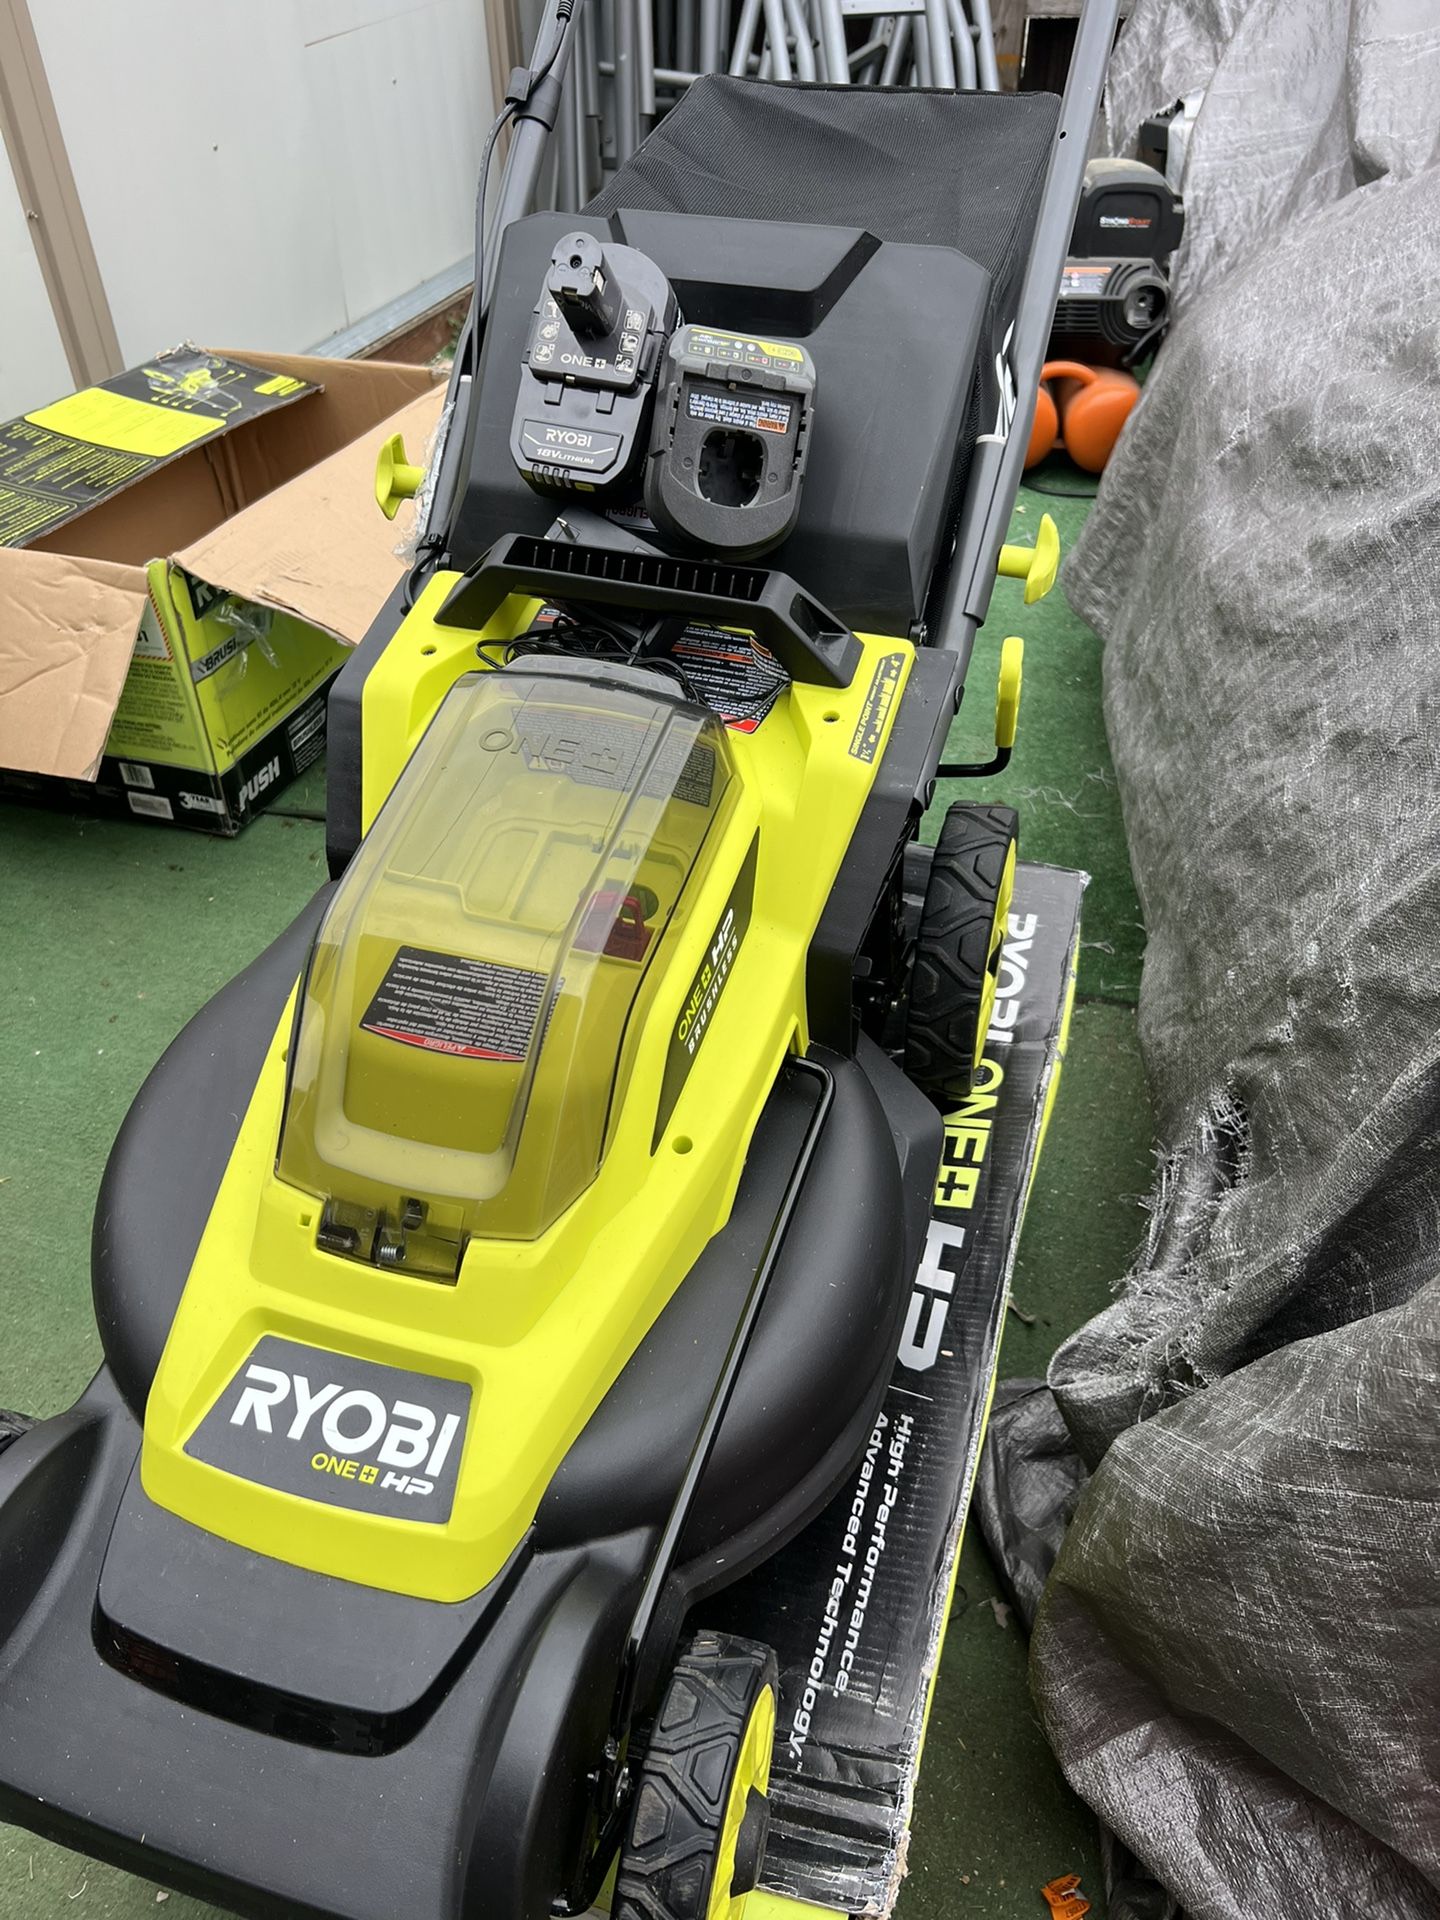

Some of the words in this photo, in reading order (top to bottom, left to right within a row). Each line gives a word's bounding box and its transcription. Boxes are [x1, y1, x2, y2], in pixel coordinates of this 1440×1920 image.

[537, 448, 559, 459] 18V
[558, 454, 594, 465] LITHIUM
[545, 428, 592, 448] RYOBI
[851, 725, 865, 754] SINGLE
[861, 702, 873, 726] POINT
[239, 756, 280, 812] PUSH
[711, 908, 733, 966] HP
[688, 935, 737, 1054] BRUSHLESS
[898, 1220, 966, 1372] HP
[229, 1364, 460, 1477] RYOBI
[887, 1413, 914, 1478] High
[380, 1472, 434, 1495] HP
[841, 1411, 890, 1558] Advanced
[831, 1481, 900, 1698] Performance.
